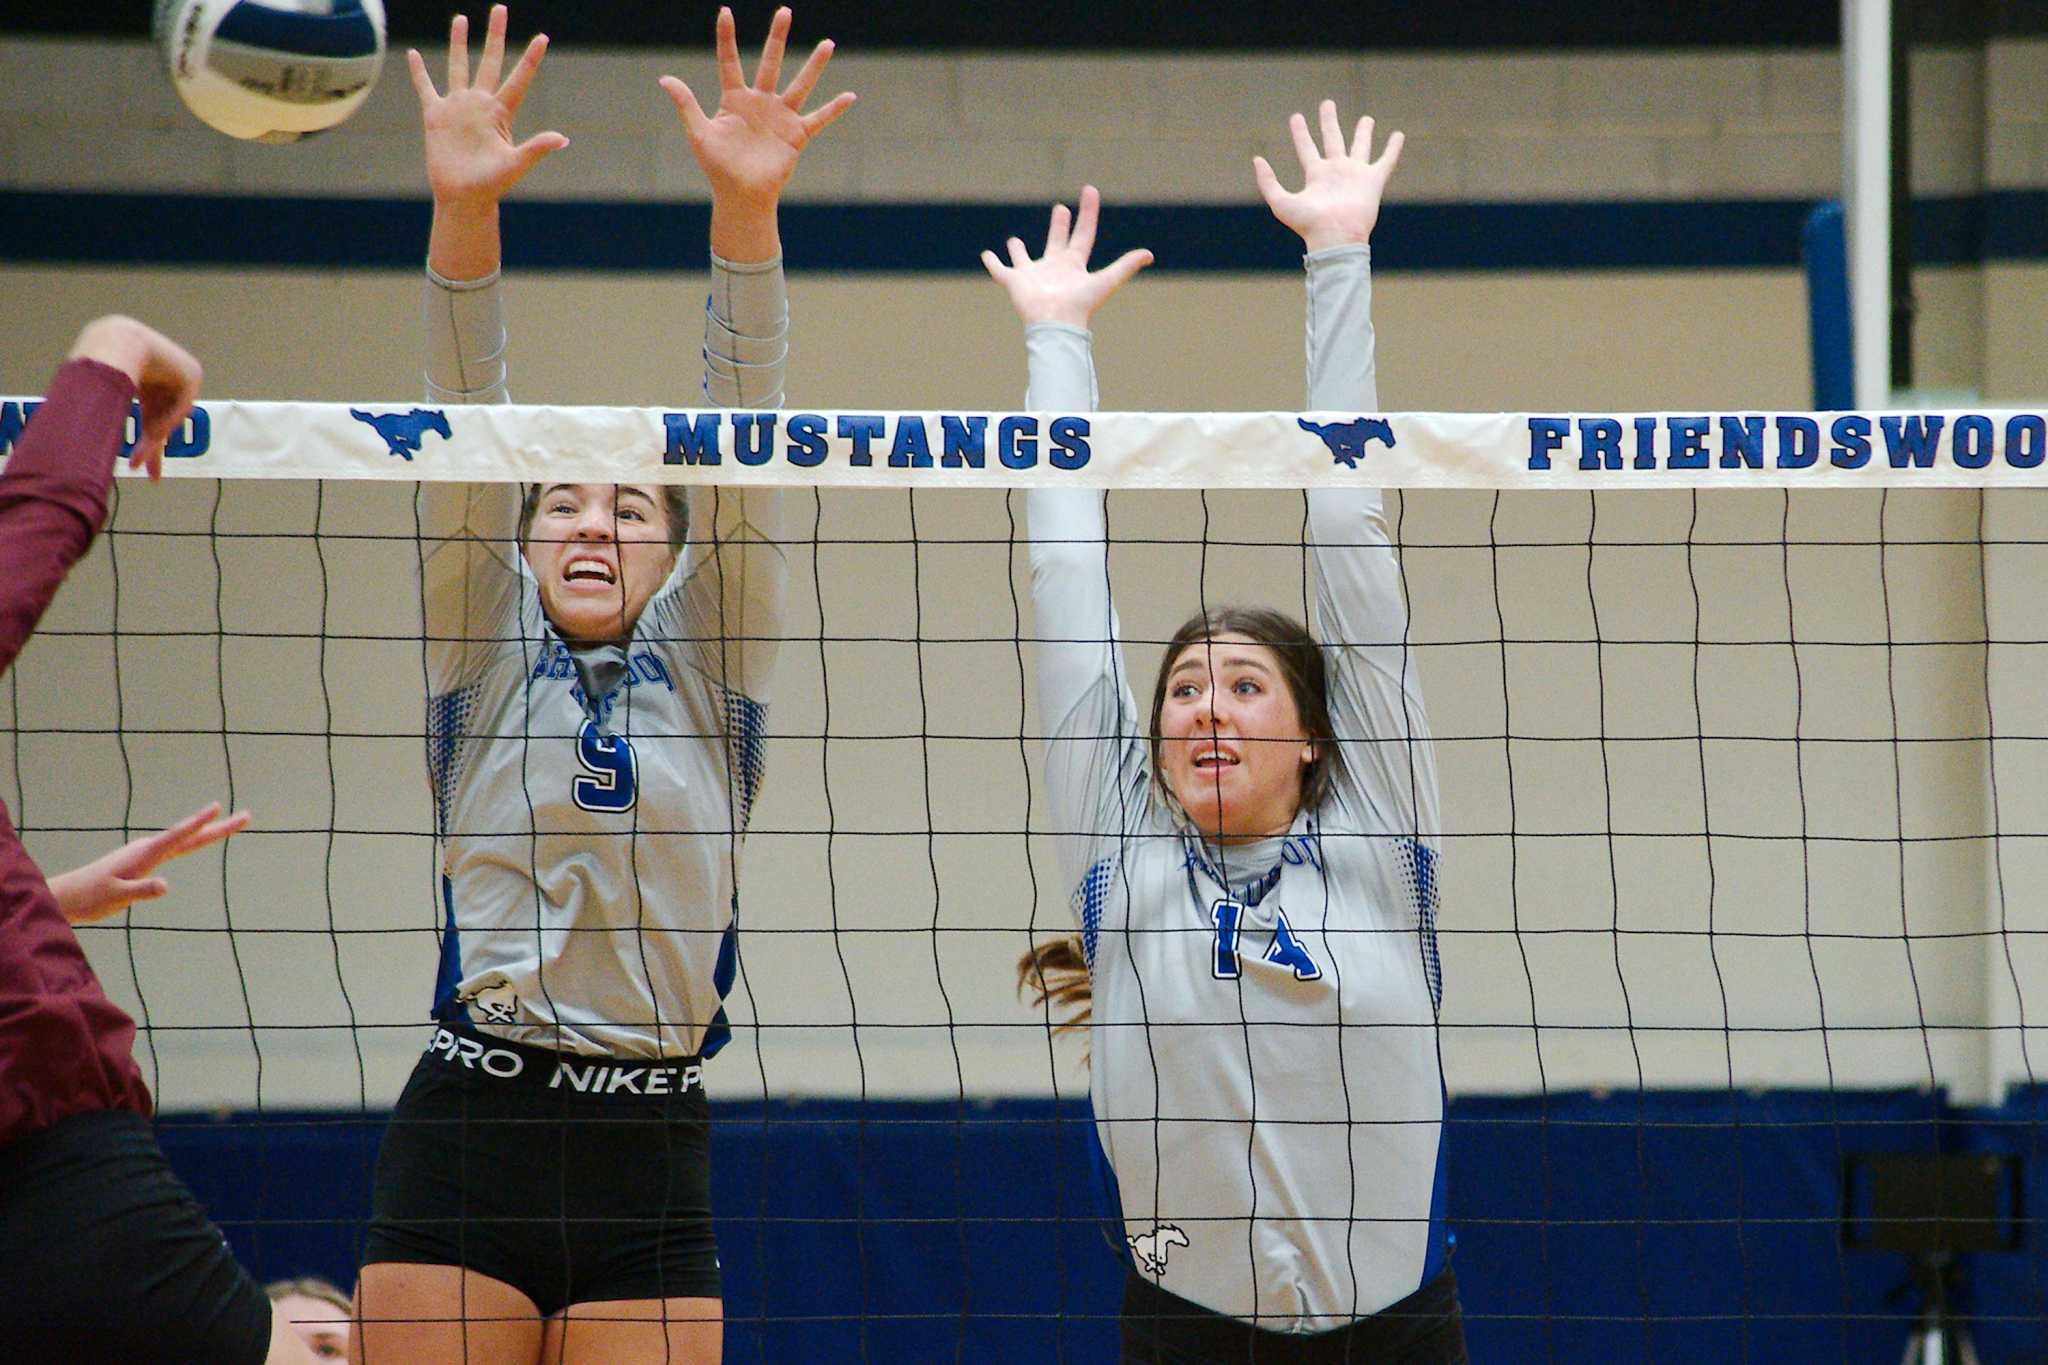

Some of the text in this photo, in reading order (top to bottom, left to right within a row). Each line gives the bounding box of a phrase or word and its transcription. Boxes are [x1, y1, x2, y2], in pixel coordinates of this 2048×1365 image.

[663, 413, 1091, 469] MUSTANGS
[430, 1029, 524, 1078] PRO
[549, 1062, 677, 1094] NIKE
